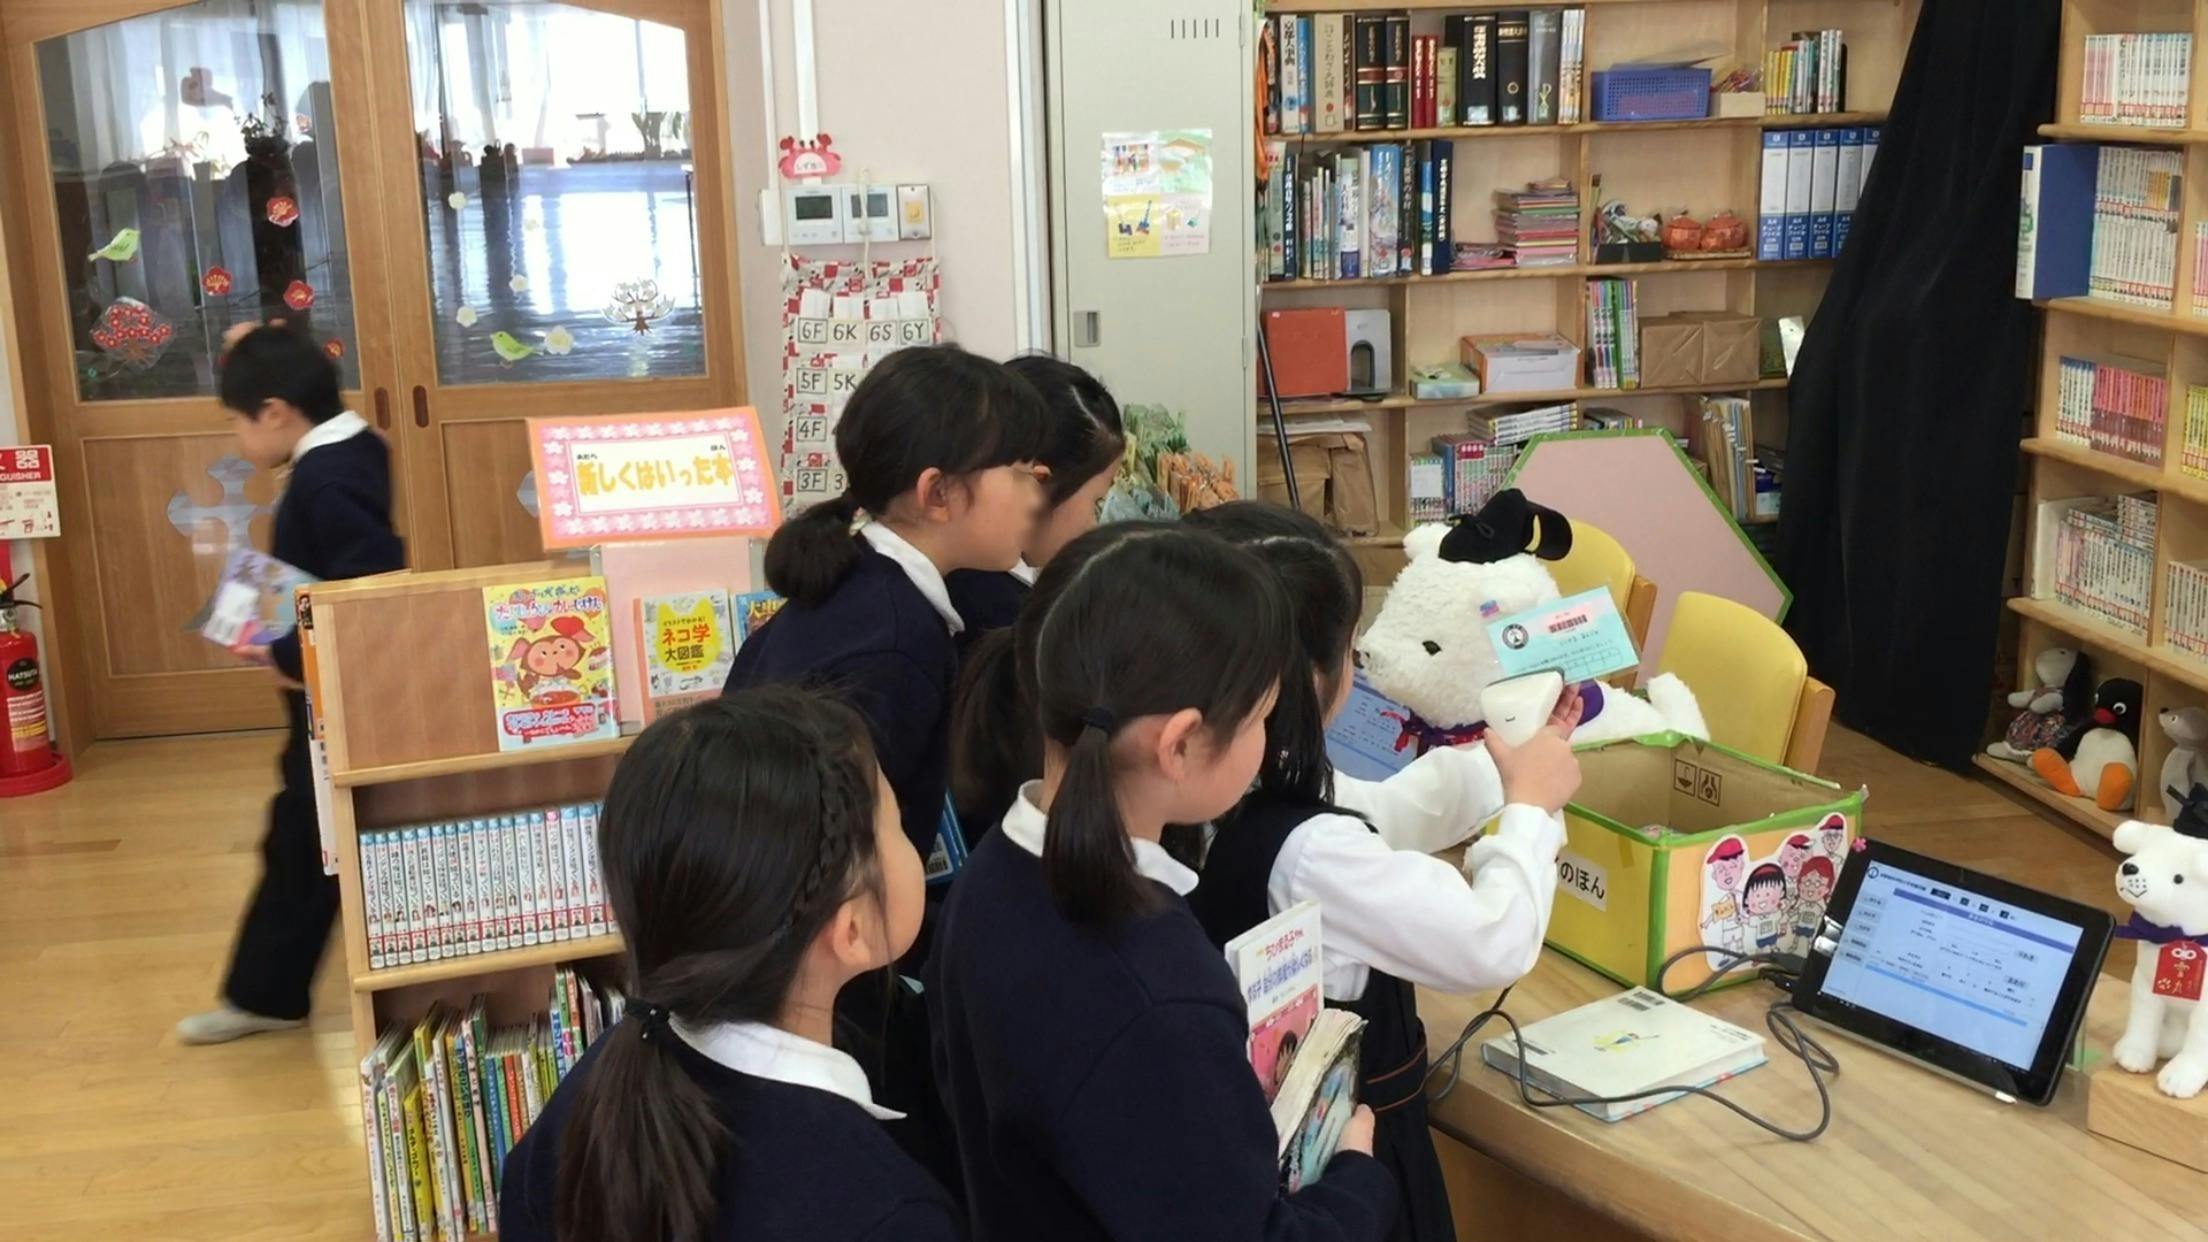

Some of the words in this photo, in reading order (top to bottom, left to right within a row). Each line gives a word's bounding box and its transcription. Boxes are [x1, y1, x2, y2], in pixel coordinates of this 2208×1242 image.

[802, 321, 824, 340] 6F
[833, 323, 857, 341] 6K
[869, 324, 893, 341] 6S
[903, 323, 924, 341] 6Y
[801, 373, 822, 390] 5F
[834, 373, 858, 390] 5K
[799, 421, 822, 439] 4F
[577, 453, 734, 495] 新しくはいった本
[801, 472, 822, 490] 3F
[662, 623, 711, 646] ネコ学
[665, 644, 705, 662] 大図鑑
[1555, 857, 1605, 900] のほん
